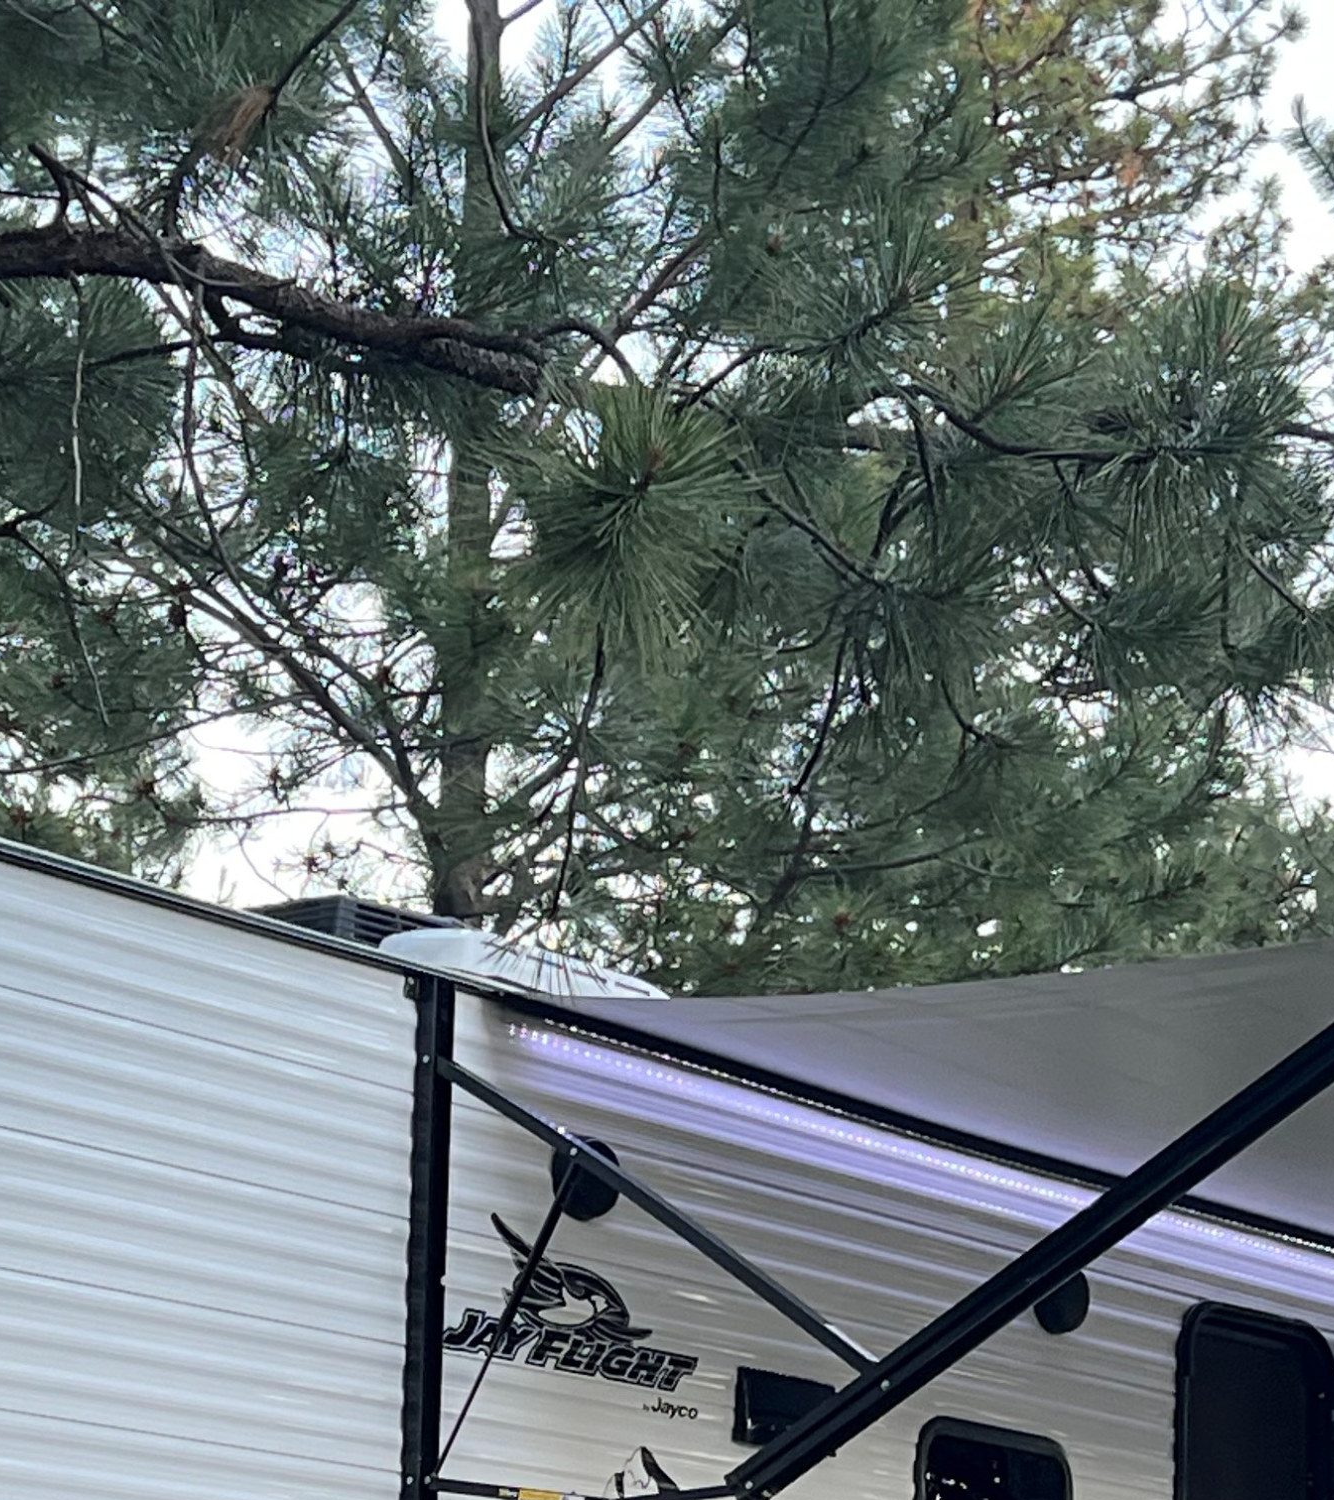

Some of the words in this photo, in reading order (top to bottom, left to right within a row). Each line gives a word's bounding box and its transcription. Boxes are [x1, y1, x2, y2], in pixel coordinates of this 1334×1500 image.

[443, 1307, 541, 1361] JAY
[524, 1327, 699, 1392] FLIGHT
[651, 1396, 699, 1420] Jayco
